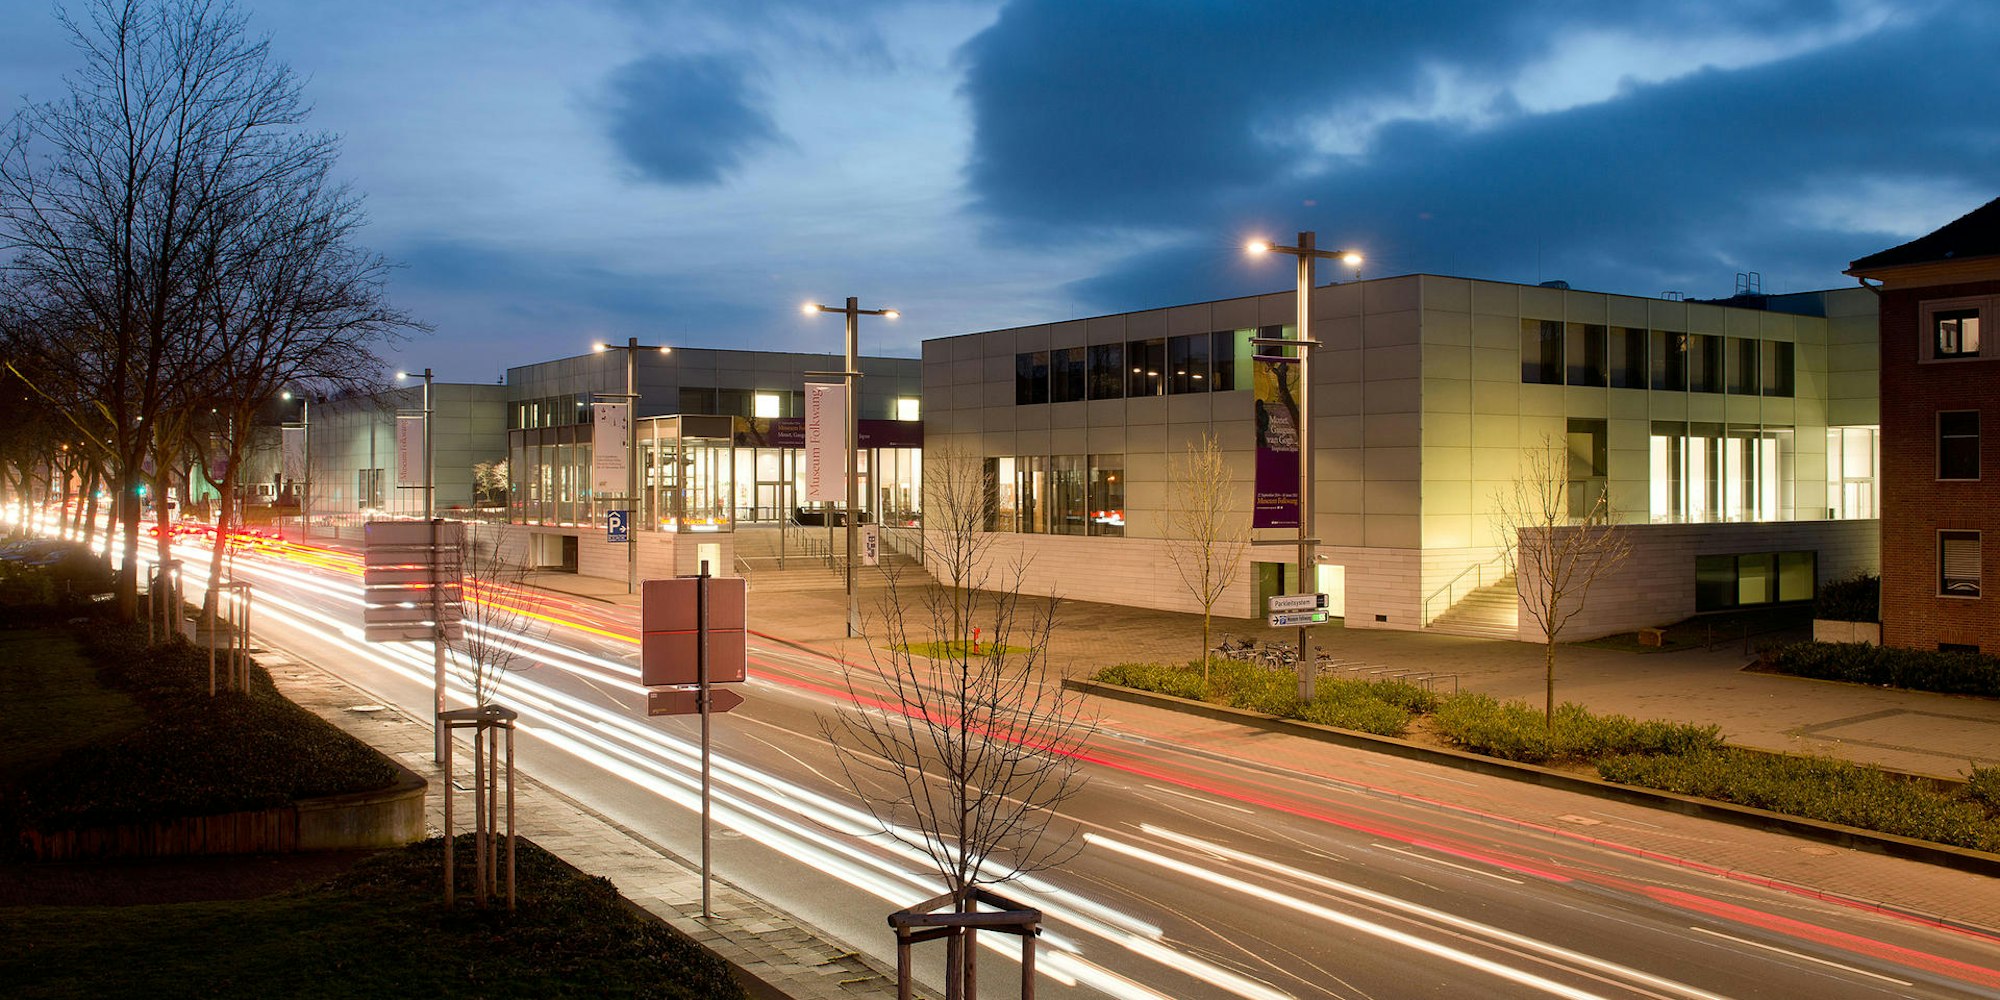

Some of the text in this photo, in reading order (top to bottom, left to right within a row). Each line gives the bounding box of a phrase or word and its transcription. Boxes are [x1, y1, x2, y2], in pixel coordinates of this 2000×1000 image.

[810, 389, 823, 496] Museum Folkwang
[609, 518, 621, 533] P
